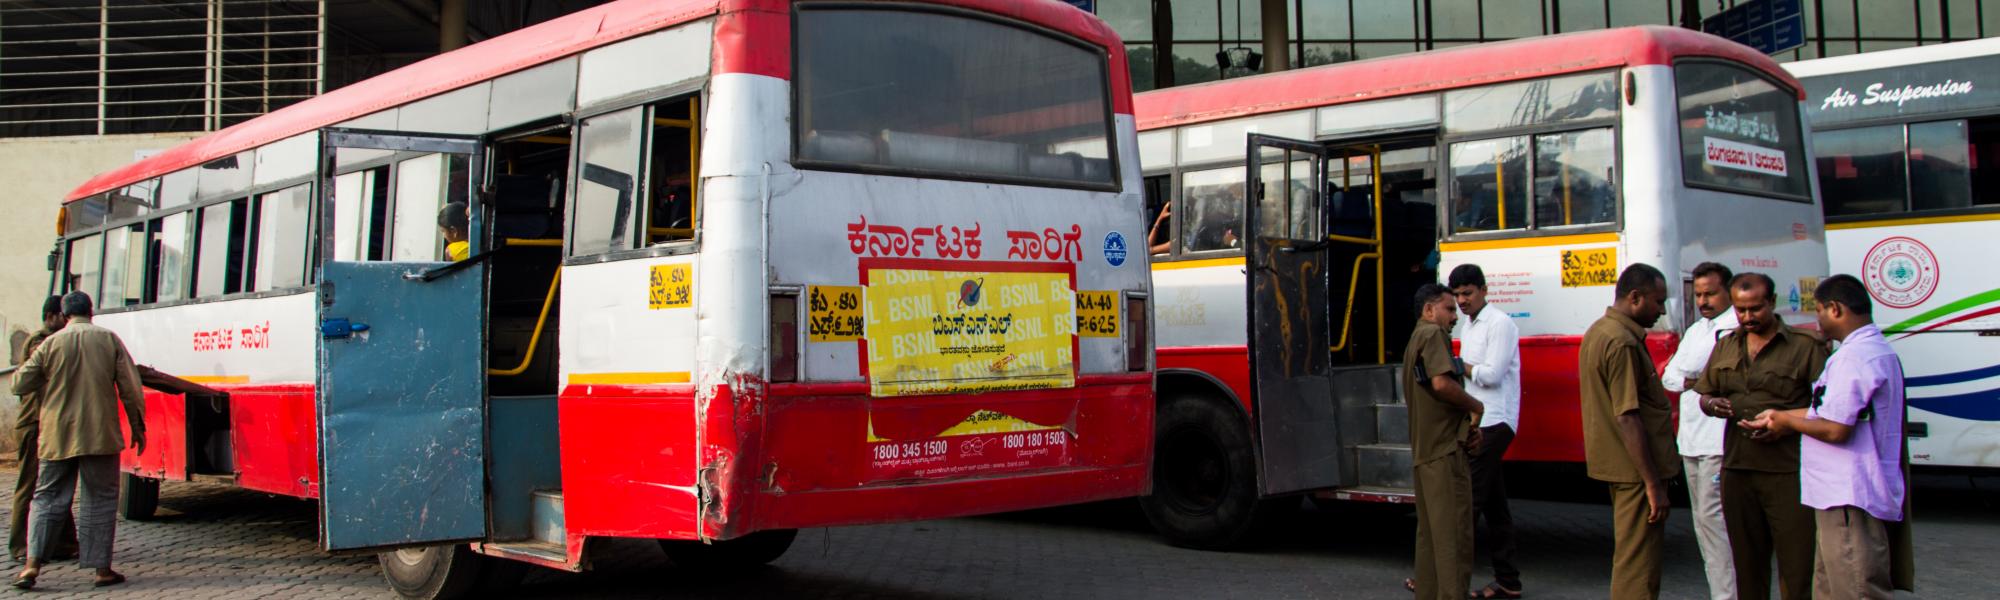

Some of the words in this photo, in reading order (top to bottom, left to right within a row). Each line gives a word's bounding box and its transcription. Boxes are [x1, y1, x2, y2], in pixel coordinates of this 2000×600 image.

[1821, 87, 1857, 110] Air
[1862, 79, 1973, 108] Suspension
[848, 214, 981, 259] ಕರ್ನಾಟಕ
[1007, 224, 1082, 263] ಸಾರಿಗೆ
[1001, 283, 1045, 308] BSNL
[194, 328, 232, 351] ಕರ್ನಾಟಕ
[241, 320, 269, 348] ಸಾರಿಗೆ
[873, 443, 900, 460] 1800
[902, 442, 921, 458] 345
[923, 439, 948, 456] 1500
[1002, 434, 1025, 449] 1800
[1027, 432, 1043, 447] 180
[1045, 430, 1066, 445] 1503
